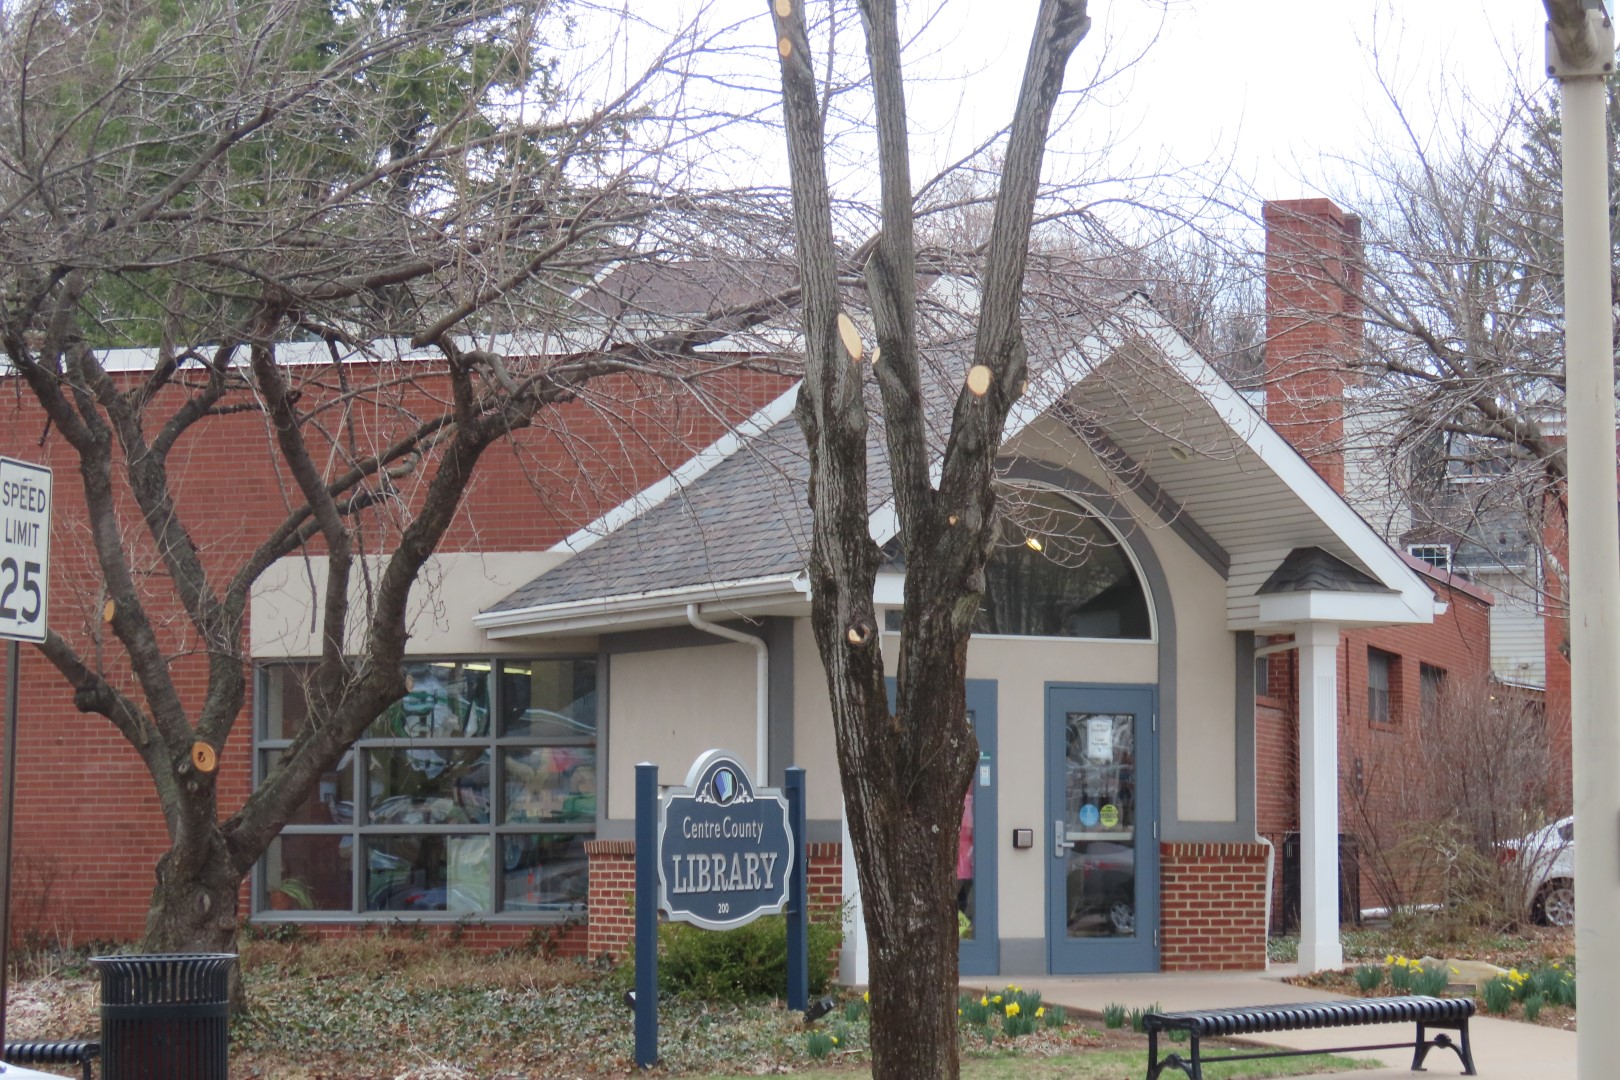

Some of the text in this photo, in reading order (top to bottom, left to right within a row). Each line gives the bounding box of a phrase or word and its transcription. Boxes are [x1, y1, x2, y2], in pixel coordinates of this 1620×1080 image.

[3, 481, 46, 513] SPEED
[5, 517, 40, 548] LIMIT
[0, 557, 41, 623] 25
[683, 816, 764, 844] Centre County
[672, 852, 778, 894] LIBRARY
[718, 903, 729, 914] 200
